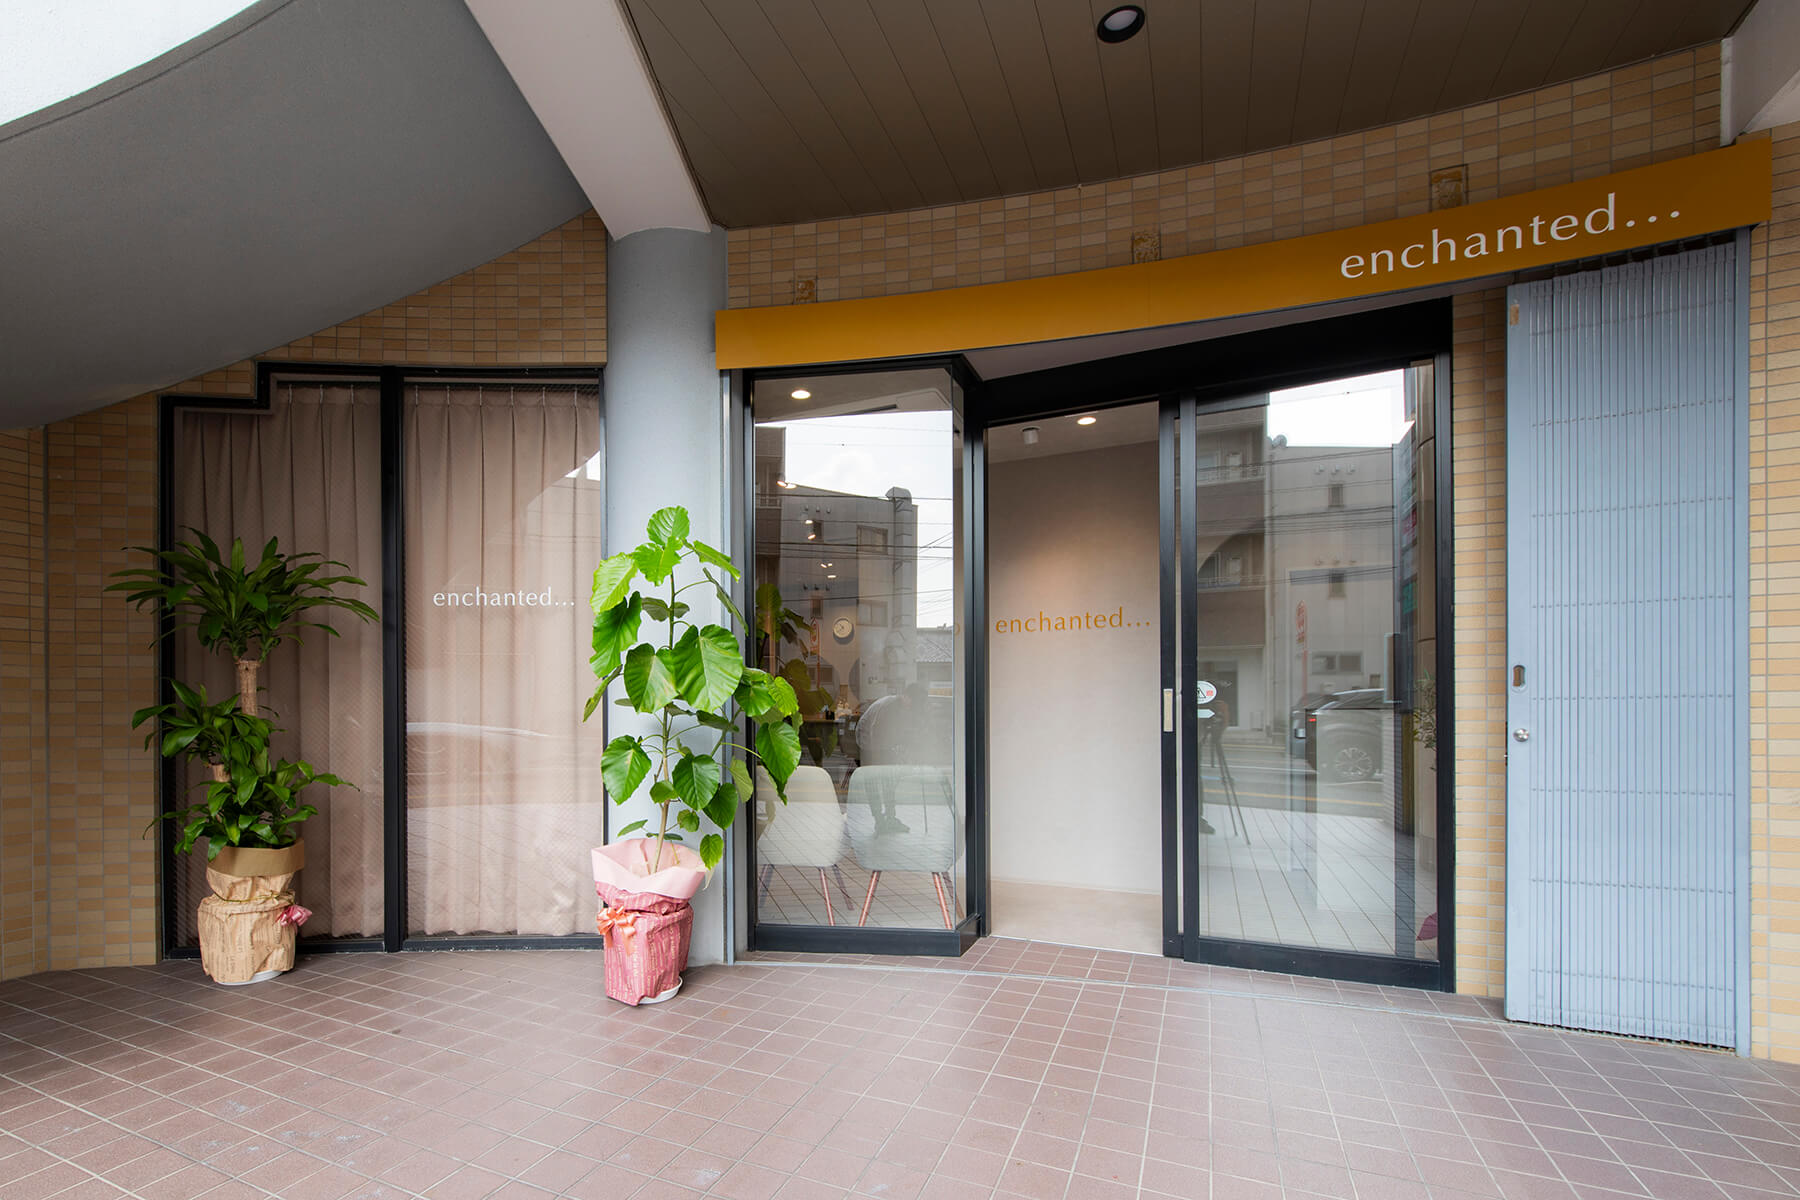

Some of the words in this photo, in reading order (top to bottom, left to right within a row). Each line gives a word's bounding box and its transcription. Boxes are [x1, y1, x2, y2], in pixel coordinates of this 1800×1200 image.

[1340, 192, 1681, 279] enchanted...
[432, 586, 575, 607] enchanted...
[995, 605, 1151, 634] enchanted...
